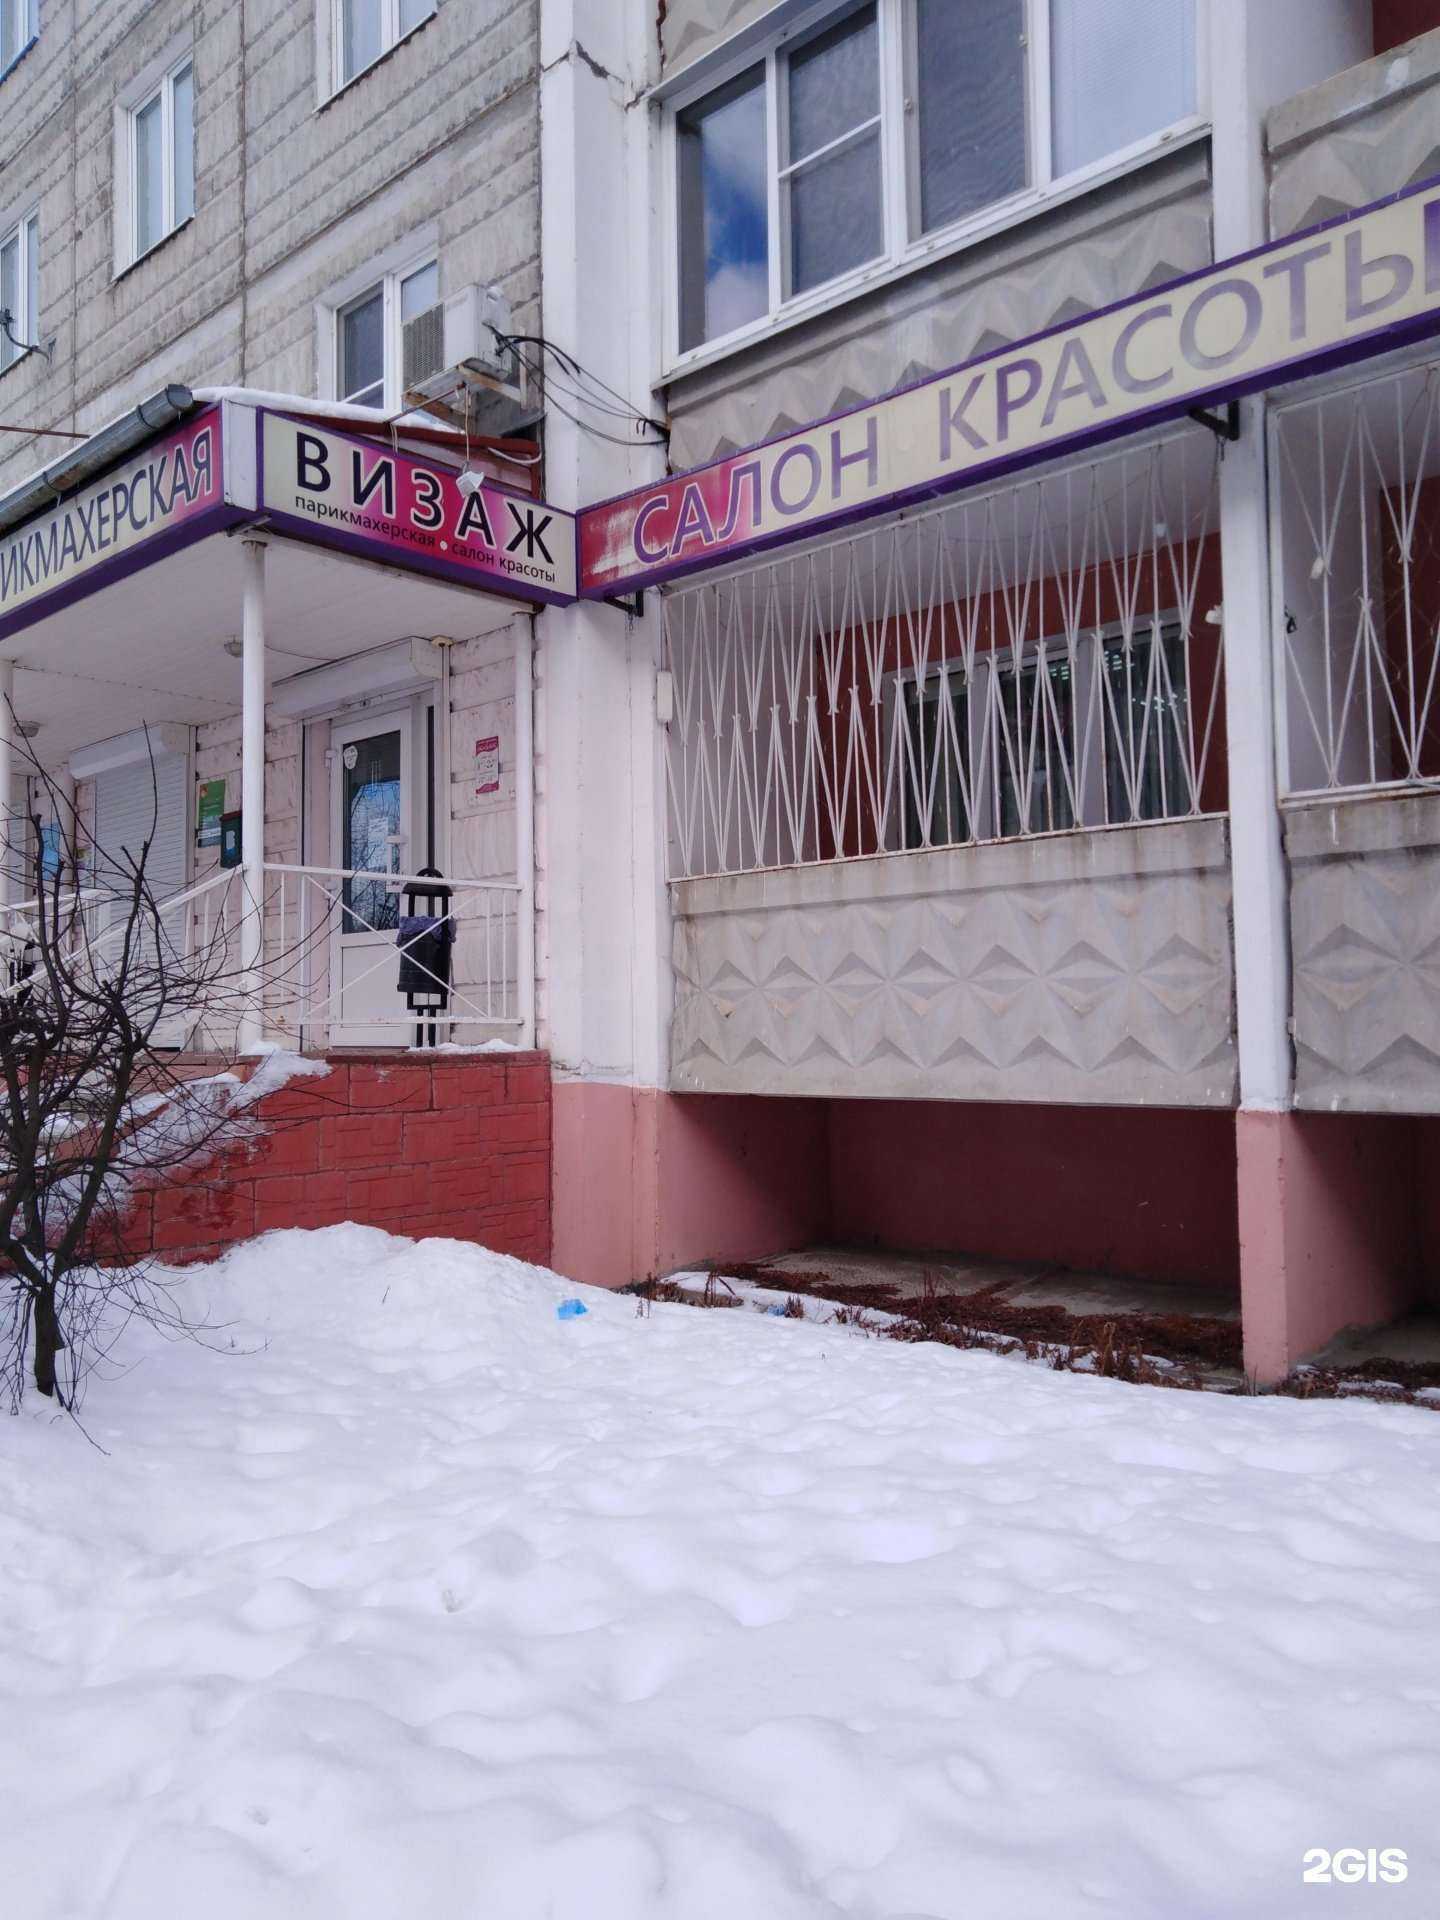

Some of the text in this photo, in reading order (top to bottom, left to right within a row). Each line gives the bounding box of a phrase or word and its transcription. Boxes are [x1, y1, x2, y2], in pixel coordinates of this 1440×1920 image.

[631, 198, 1440, 564] САЛОН КРАСОТЫ
[295, 495, 556, 583] парикмахерская салон красоты
[296, 431, 555, 565] ВИЗАЖ
